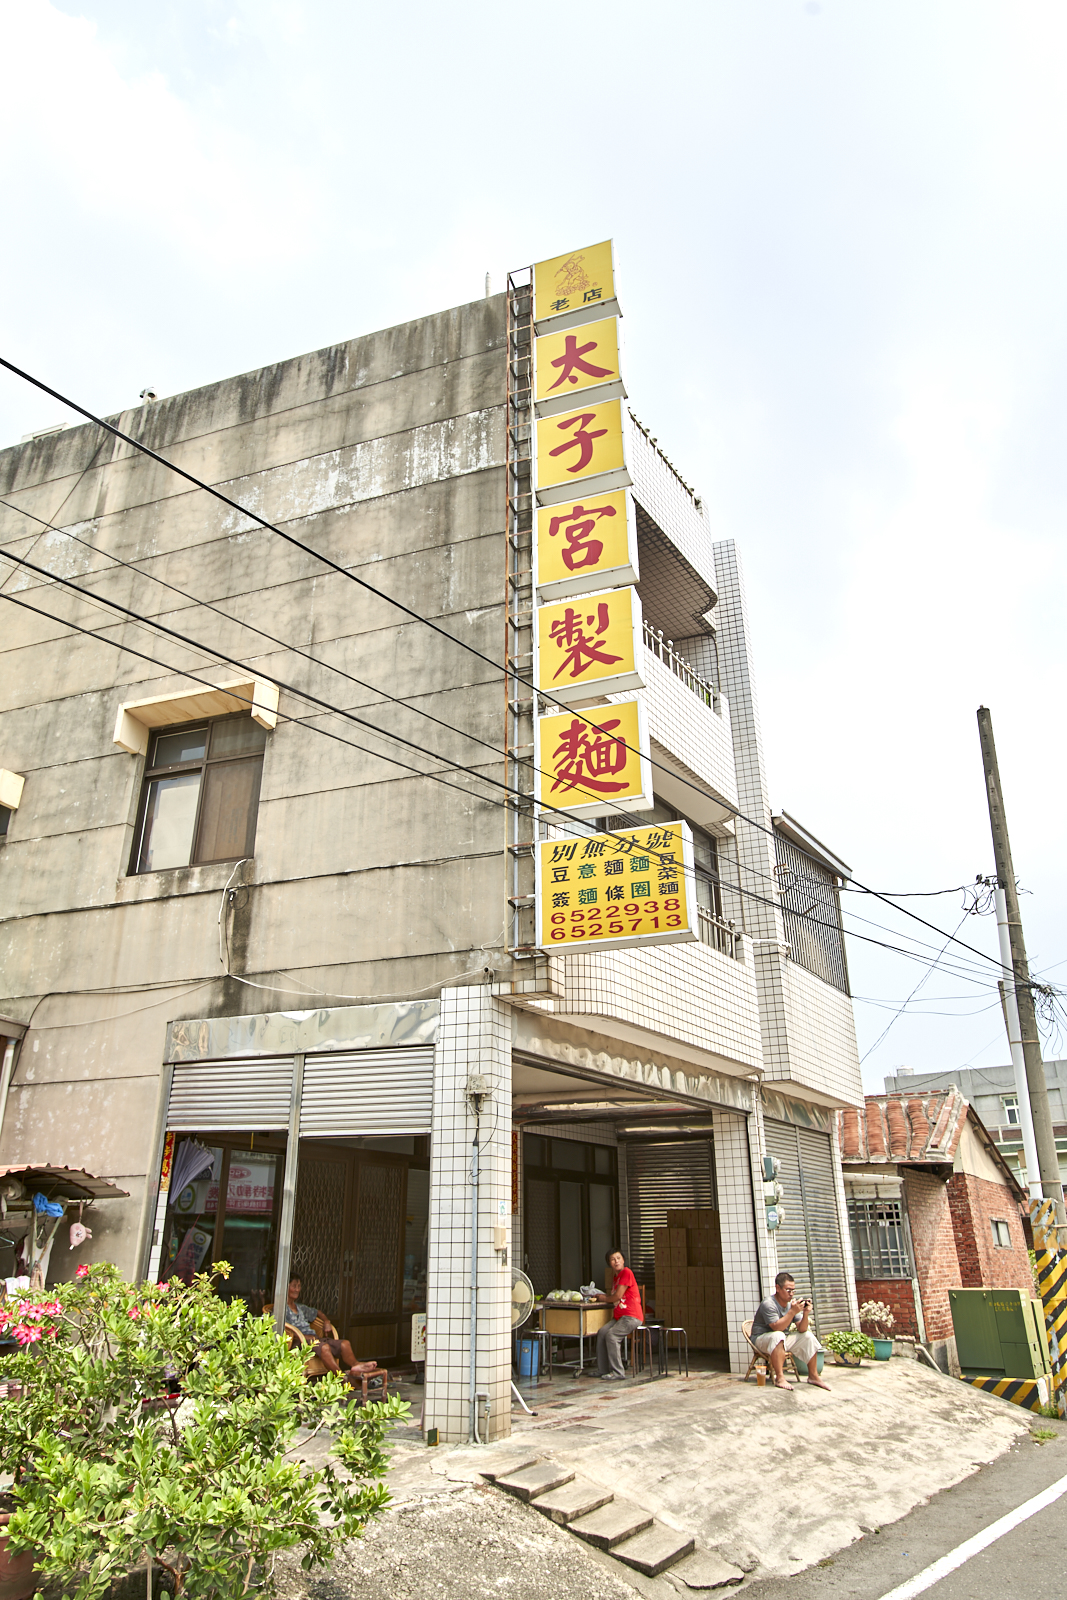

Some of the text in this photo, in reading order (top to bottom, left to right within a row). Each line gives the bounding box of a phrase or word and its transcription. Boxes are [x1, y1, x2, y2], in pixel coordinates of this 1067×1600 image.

[550, 287, 603, 312] 老店
[546, 334, 630, 794] 太子宮製麵
[547, 830, 674, 865] 別無分號
[550, 898, 681, 925] 6522938
[550, 914, 682, 941] 6525713
